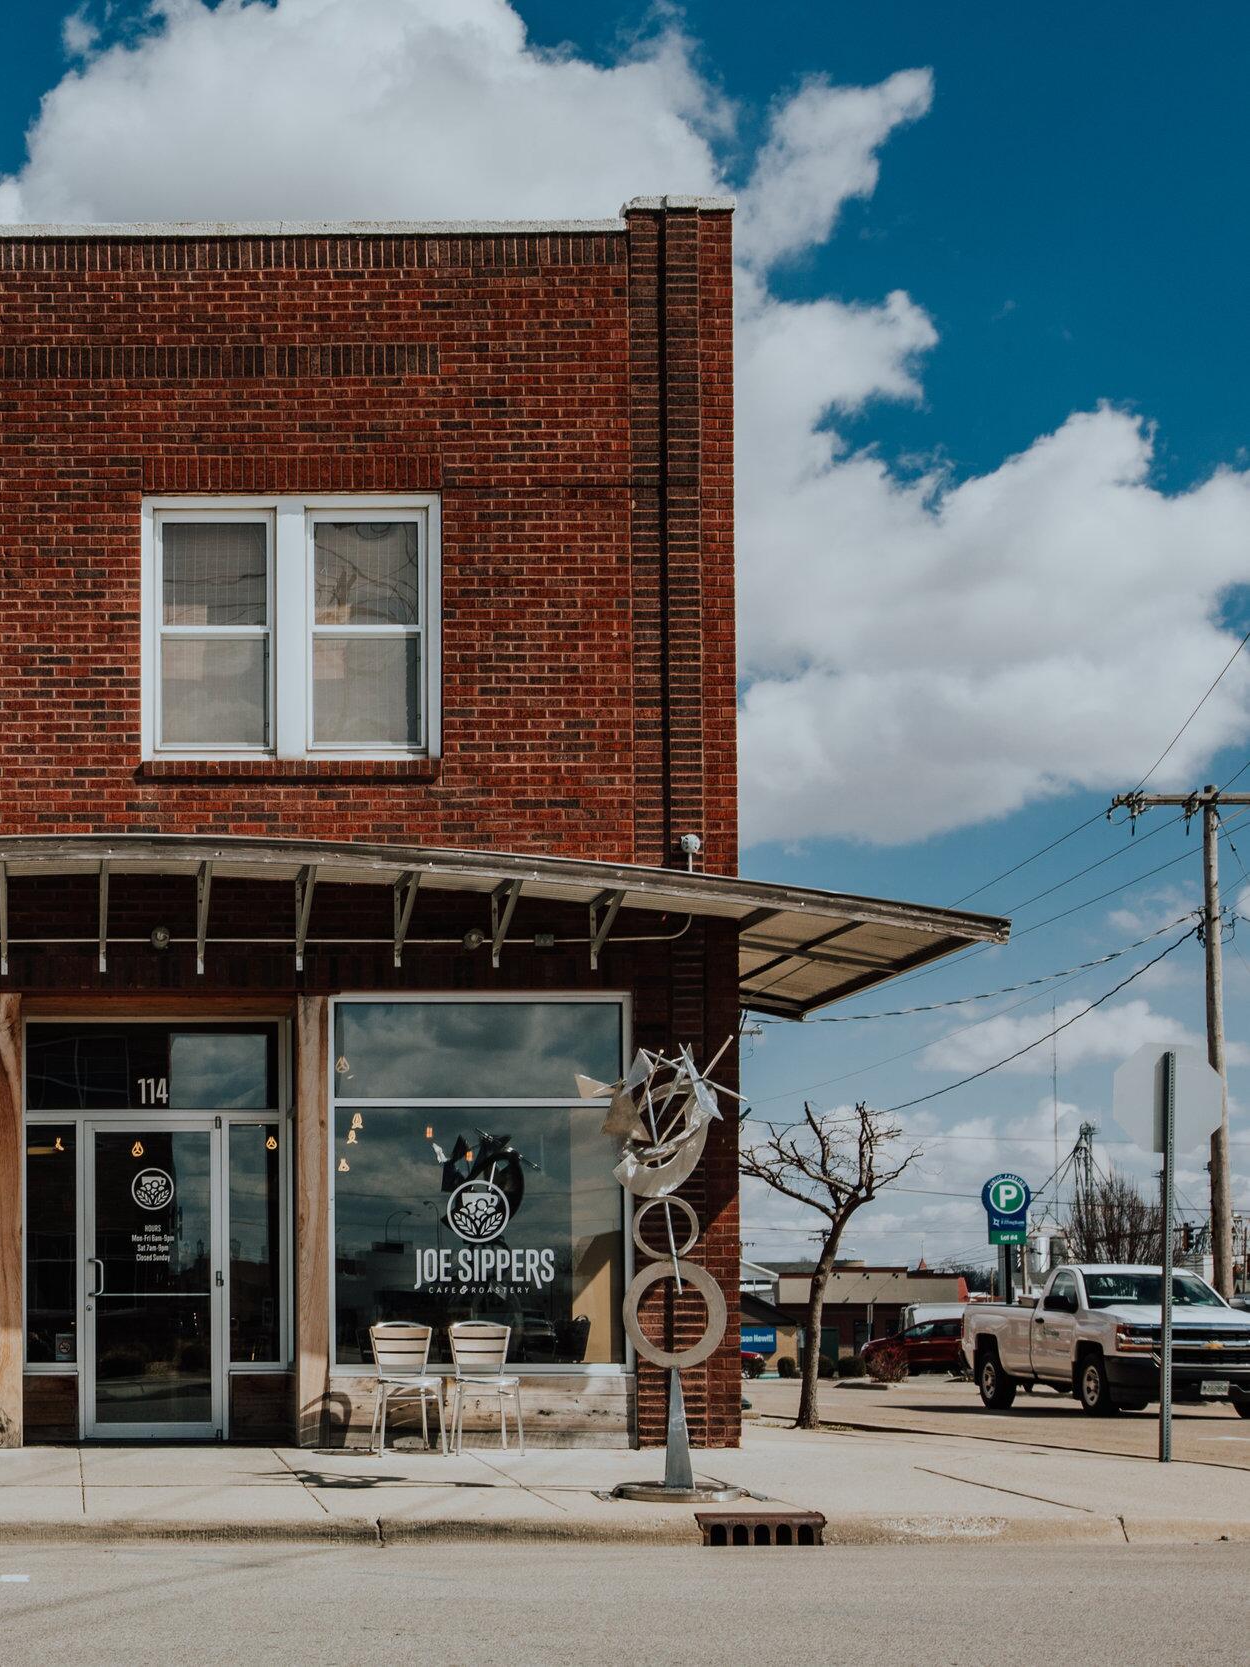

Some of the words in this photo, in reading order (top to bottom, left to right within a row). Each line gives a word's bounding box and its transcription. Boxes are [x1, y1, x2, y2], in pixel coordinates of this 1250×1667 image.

[137, 1078, 169, 1104] 114
[1004, 1173, 1027, 1189] PARKING
[999, 1184, 1018, 1208] P
[136, 1253, 152, 1261] Closed
[153, 1253, 170, 1263] Sunday
[414, 1249, 452, 1289] JOE
[458, 1249, 555, 1289] SIPPERS
[428, 1286, 457, 1294] CAFE
[459, 1285, 469, 1295] &
[471, 1286, 530, 1294] ROASTERY
[754, 1333, 774, 1342] Hewitt
